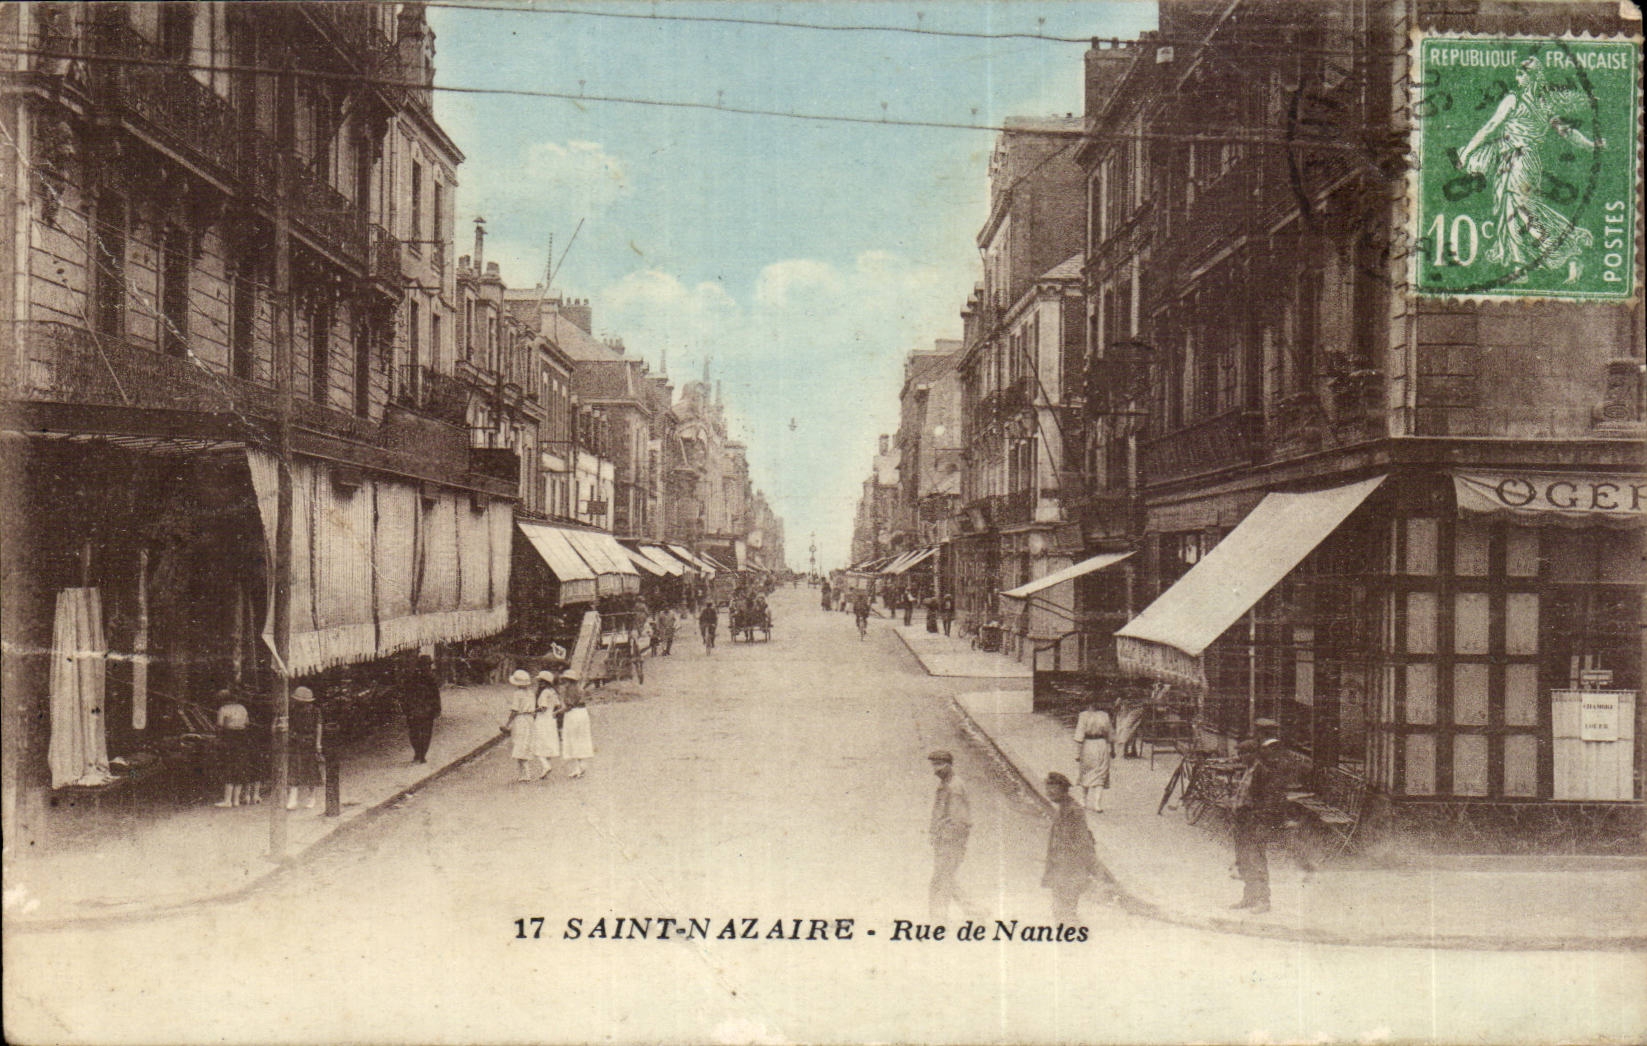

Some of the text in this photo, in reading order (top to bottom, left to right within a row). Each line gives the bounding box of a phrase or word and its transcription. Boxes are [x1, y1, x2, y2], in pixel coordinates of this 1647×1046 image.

[1430, 48, 1628, 71] REPUBLIQUE FRANÇAISE
[1603, 199, 1625, 283] POSTES
